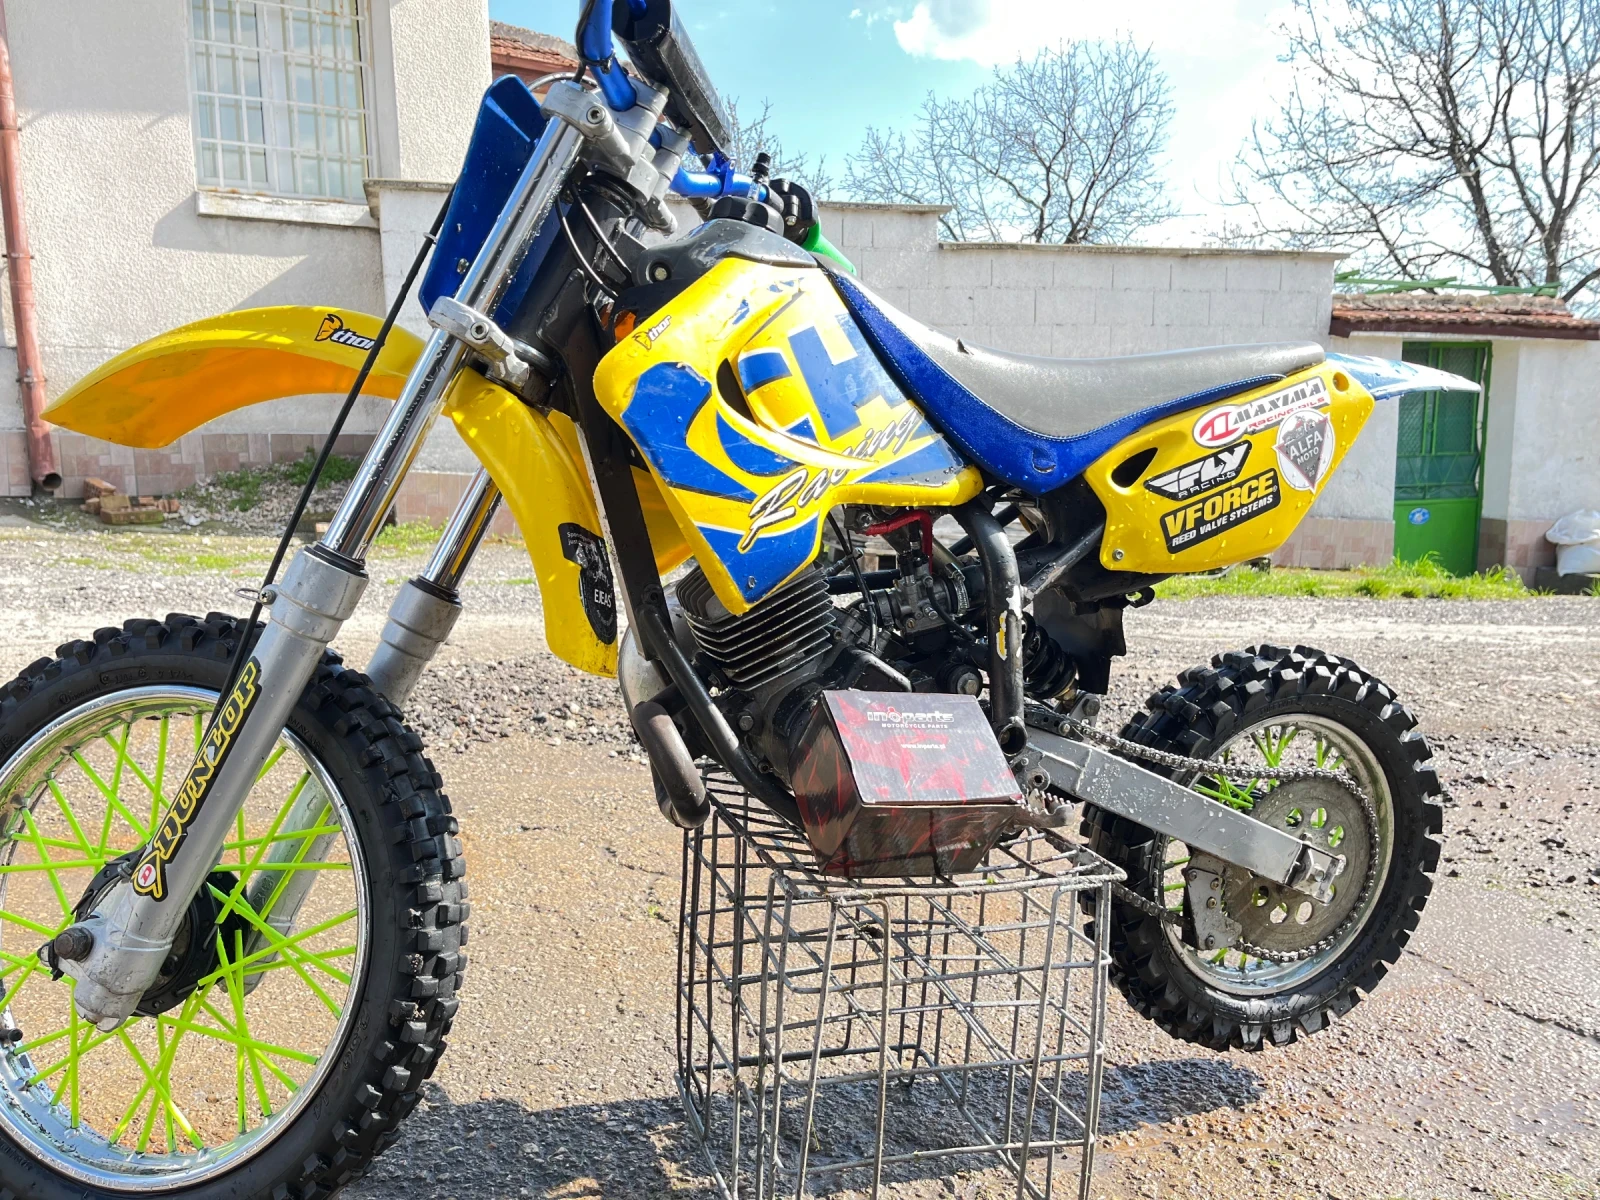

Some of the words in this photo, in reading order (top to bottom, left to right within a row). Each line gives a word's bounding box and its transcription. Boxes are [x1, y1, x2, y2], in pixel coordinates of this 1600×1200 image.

[648, 315, 672, 341] thor
[1233, 382, 1322, 425] MAXIMA
[1290, 431, 1323, 460] ALFA
[1297, 447, 1319, 465] MOTO
[1149, 443, 1249, 492] FLY
[1178, 472, 1236, 498] RACING
[1165, 472, 1275, 537] VFORCE
[1172, 531, 1197, 546] REED
[1200, 515, 1228, 535] VALVE
[1230, 495, 1273, 521] SYSTEMS
[153, 661, 257, 861] DUNLOP
